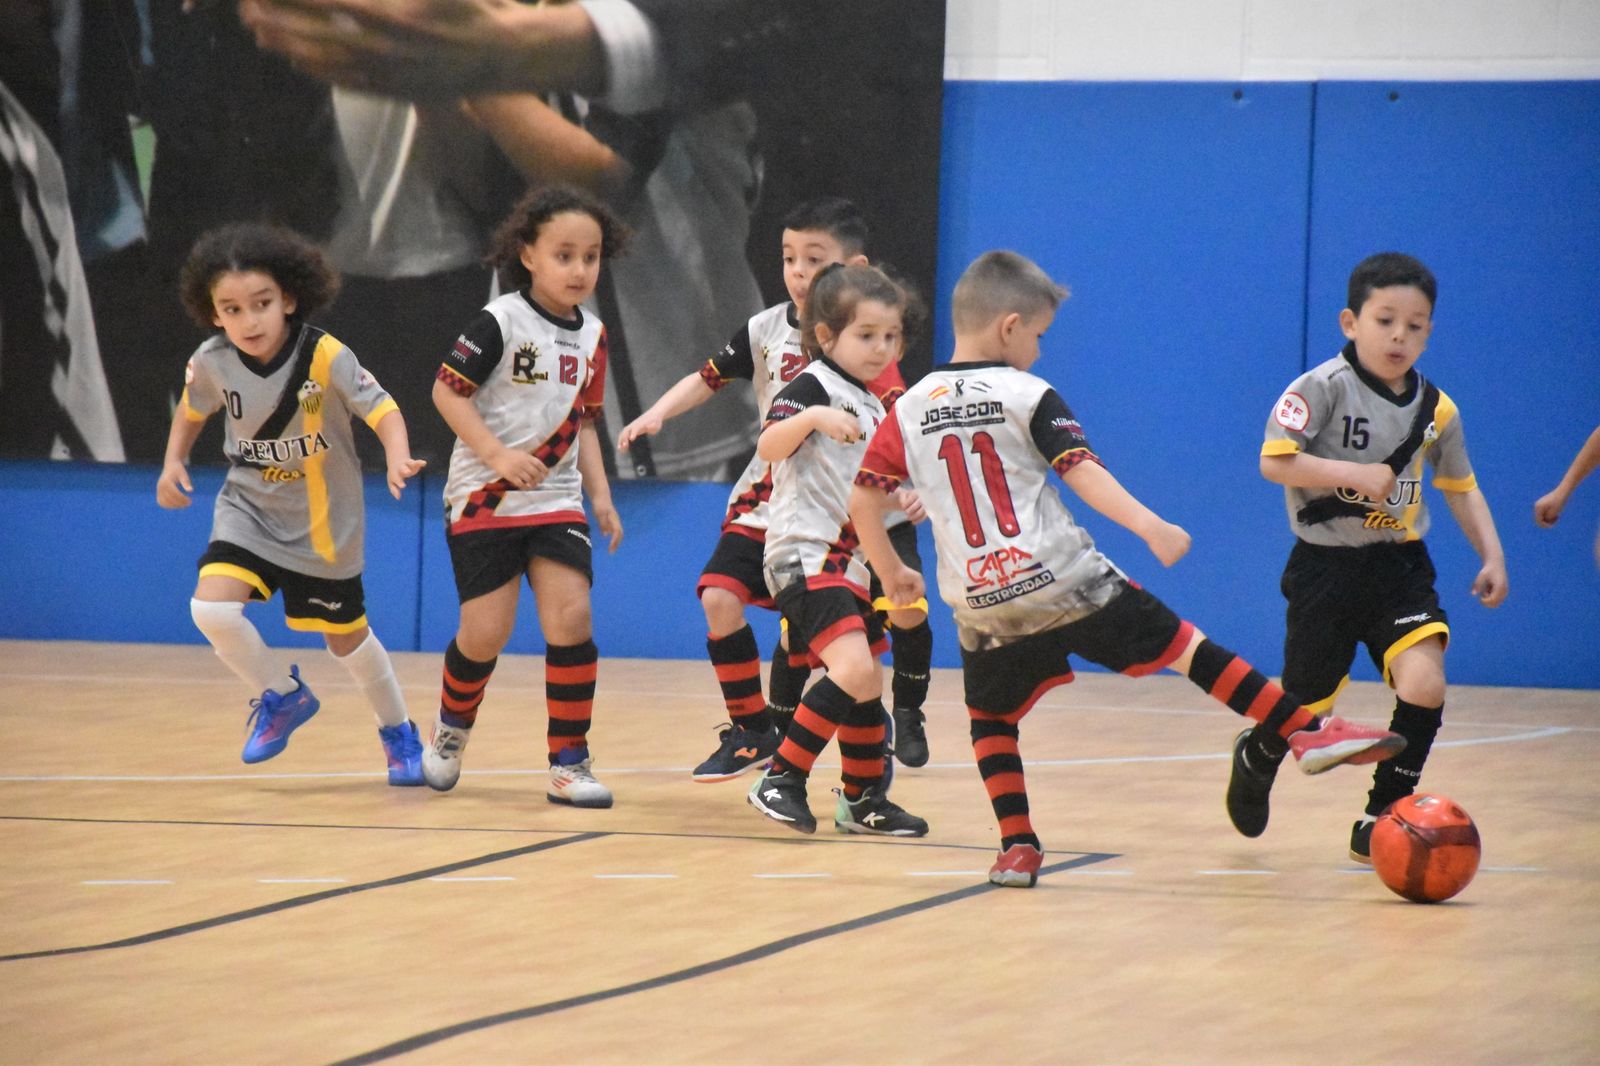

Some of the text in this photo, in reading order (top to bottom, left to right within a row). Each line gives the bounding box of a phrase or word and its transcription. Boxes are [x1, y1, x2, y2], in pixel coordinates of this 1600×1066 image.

[559, 354, 579, 386] 12
[920, 401, 1004, 427] JOSE.COM
[239, 432, 330, 463] CEUTA
[1342, 415, 1370, 450] 15
[938, 431, 1021, 548] 11
[967, 546, 1033, 584] CAPA
[967, 571, 1053, 609] ELECTRICIDAD
